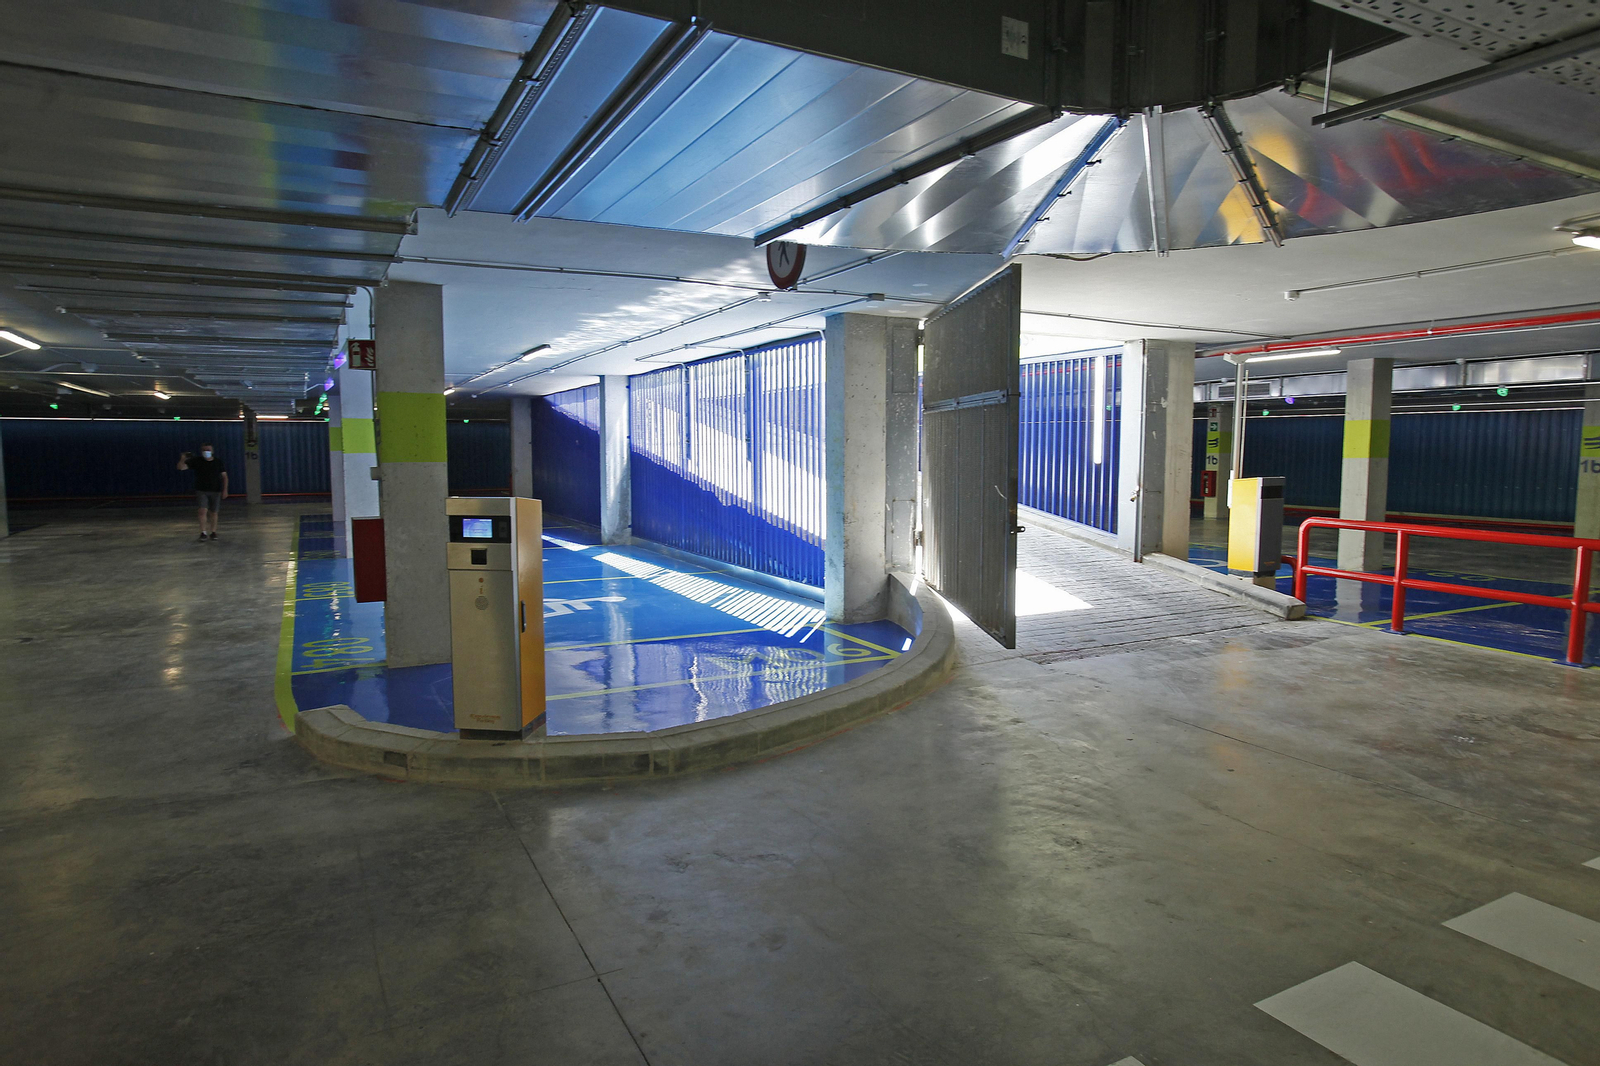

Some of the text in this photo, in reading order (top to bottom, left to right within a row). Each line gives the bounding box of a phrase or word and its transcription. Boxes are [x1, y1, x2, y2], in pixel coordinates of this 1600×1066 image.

[1206, 455, 1218, 466] 1b
[1580, 459, 1600, 474] 1b
[300, 637, 376, 669] 084
